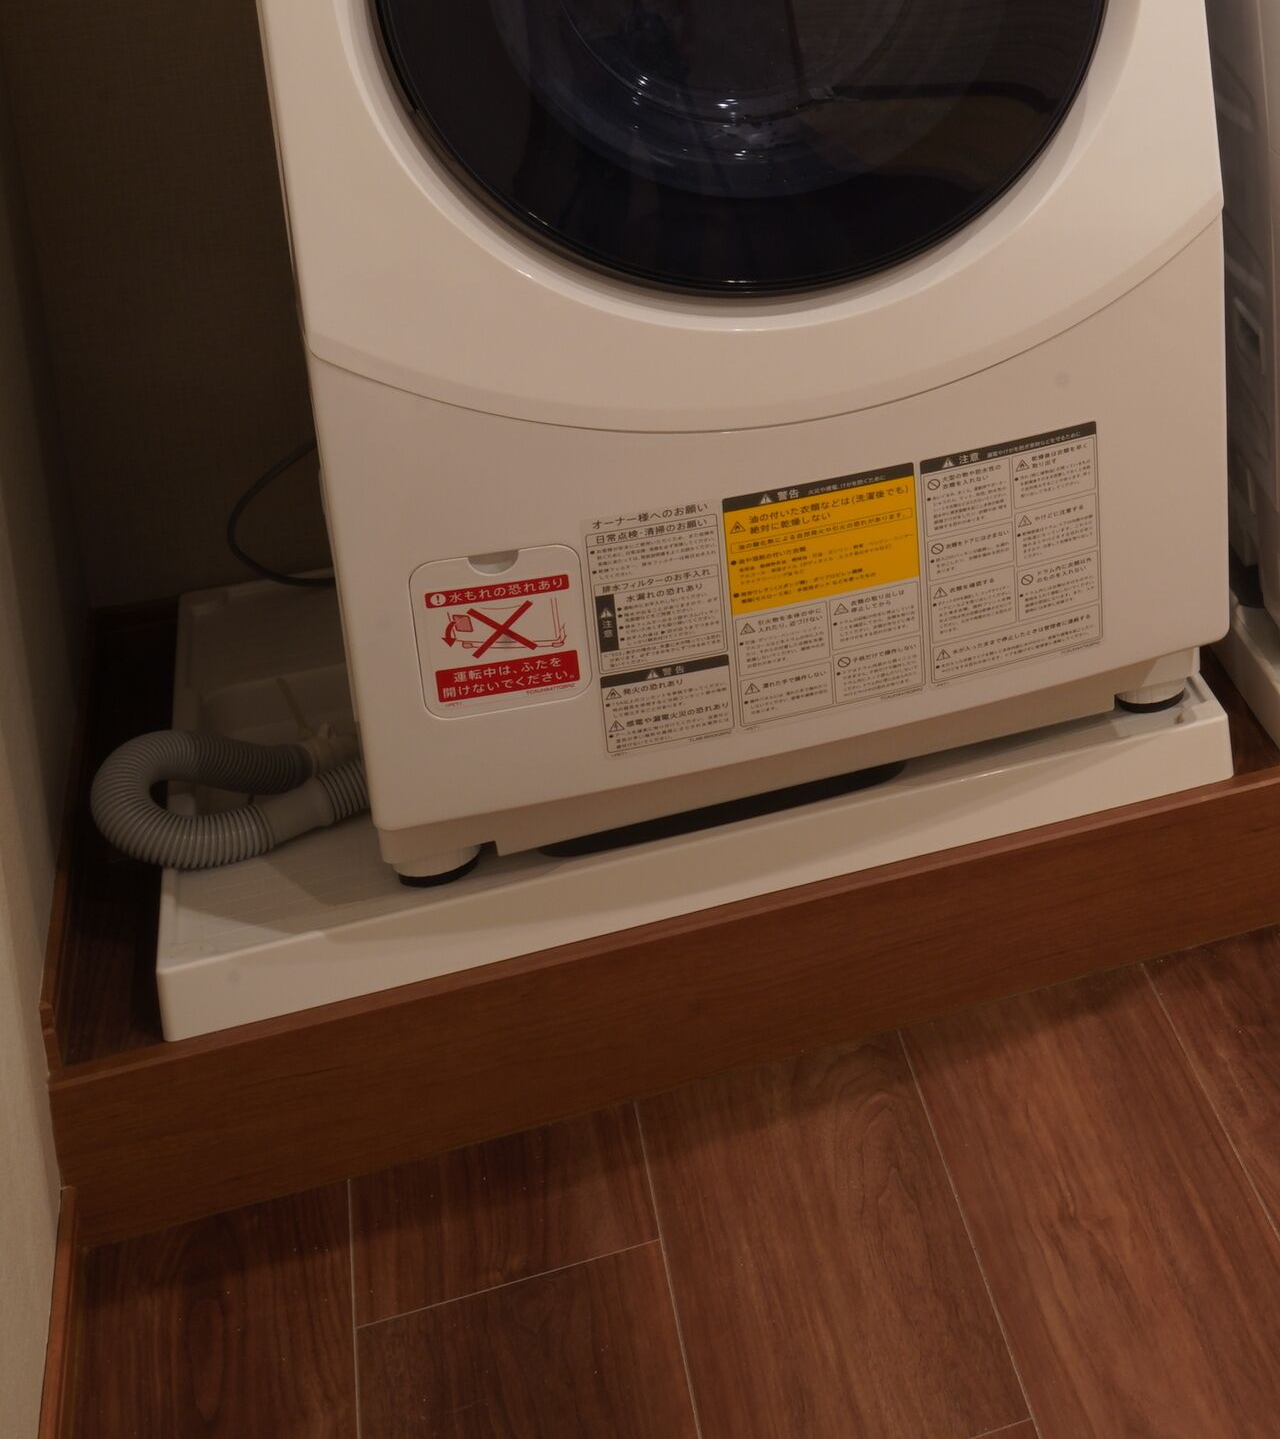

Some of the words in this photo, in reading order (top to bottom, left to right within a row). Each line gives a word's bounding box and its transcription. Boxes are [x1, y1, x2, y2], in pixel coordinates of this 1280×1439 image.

[593, 503, 708, 529] オーナー様へのお願い
[450, 578, 563, 603] 水もれの恐れあり
[453, 657, 562, 683] 運転中は、ふたを
[442, 671, 575, 698] 開けないでください。
